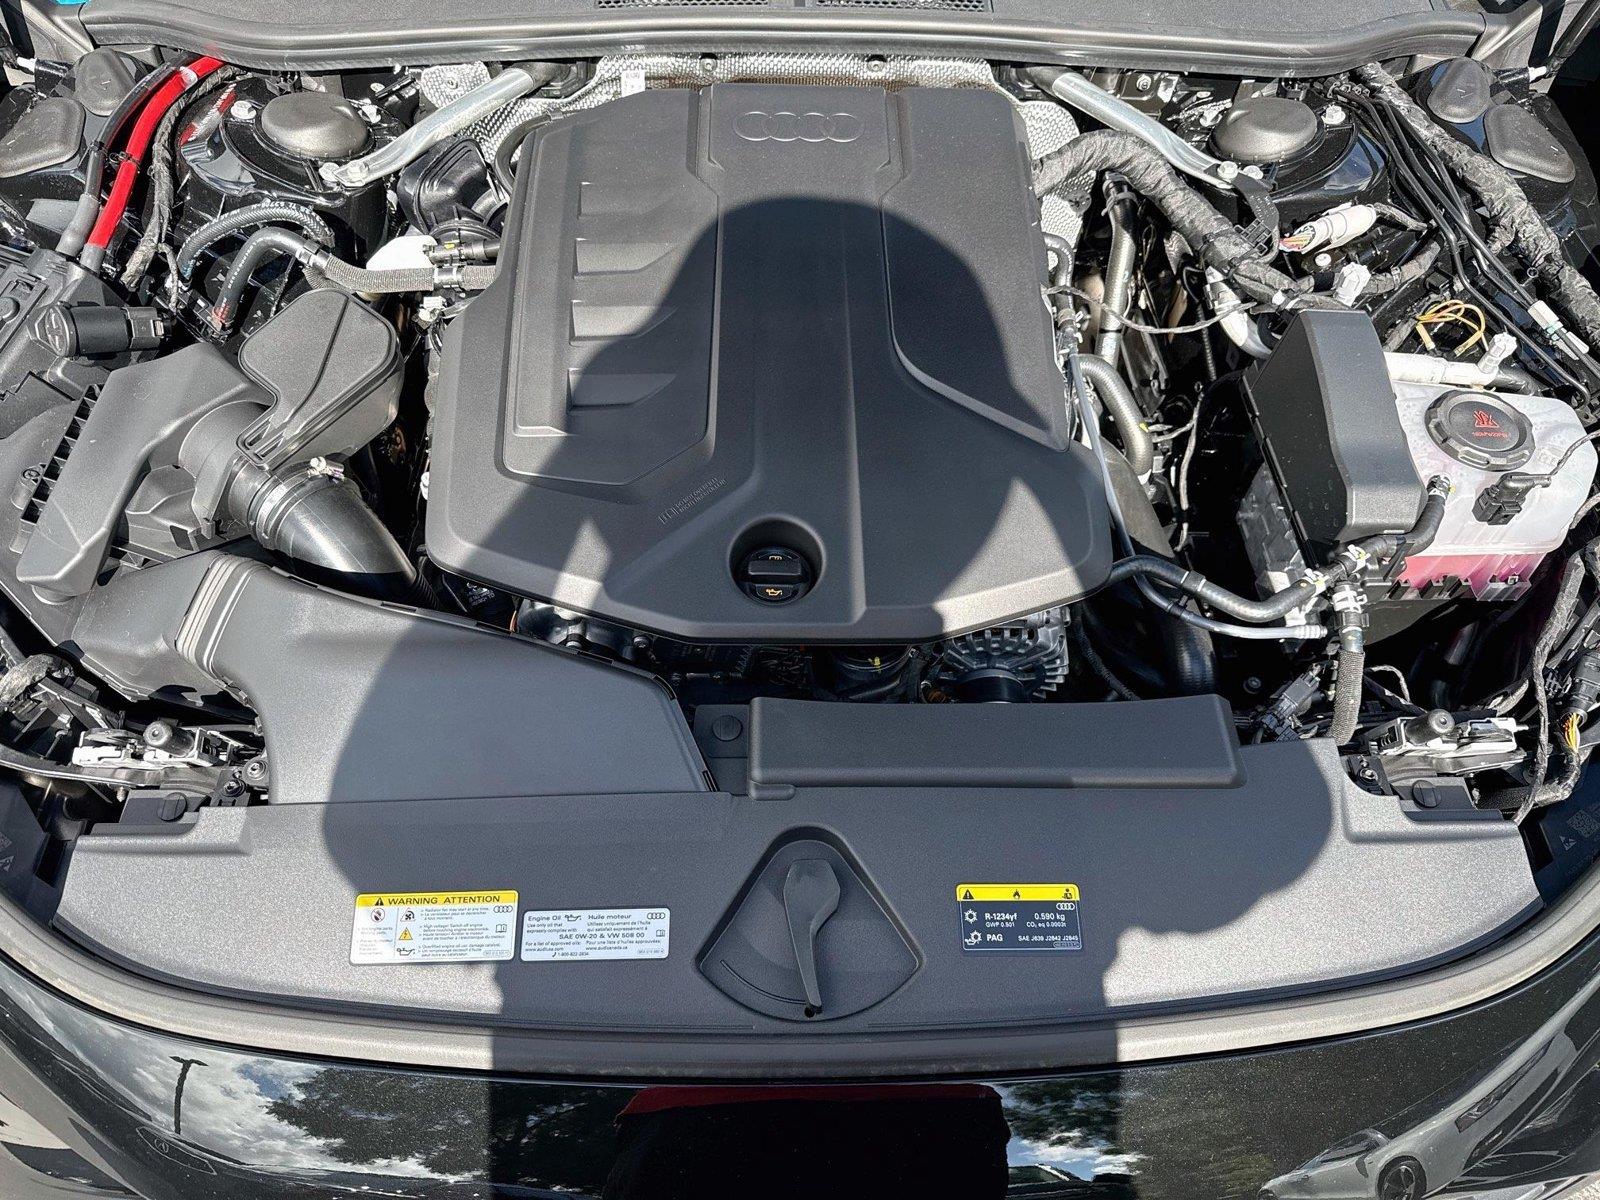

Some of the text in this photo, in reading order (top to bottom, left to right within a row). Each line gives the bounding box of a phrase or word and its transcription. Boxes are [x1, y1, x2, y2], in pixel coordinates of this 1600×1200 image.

[444, 895, 500, 904] ATTENTION
[985, 913, 1017, 921] R-1234yf
[1056, 913, 1065, 921] kg
